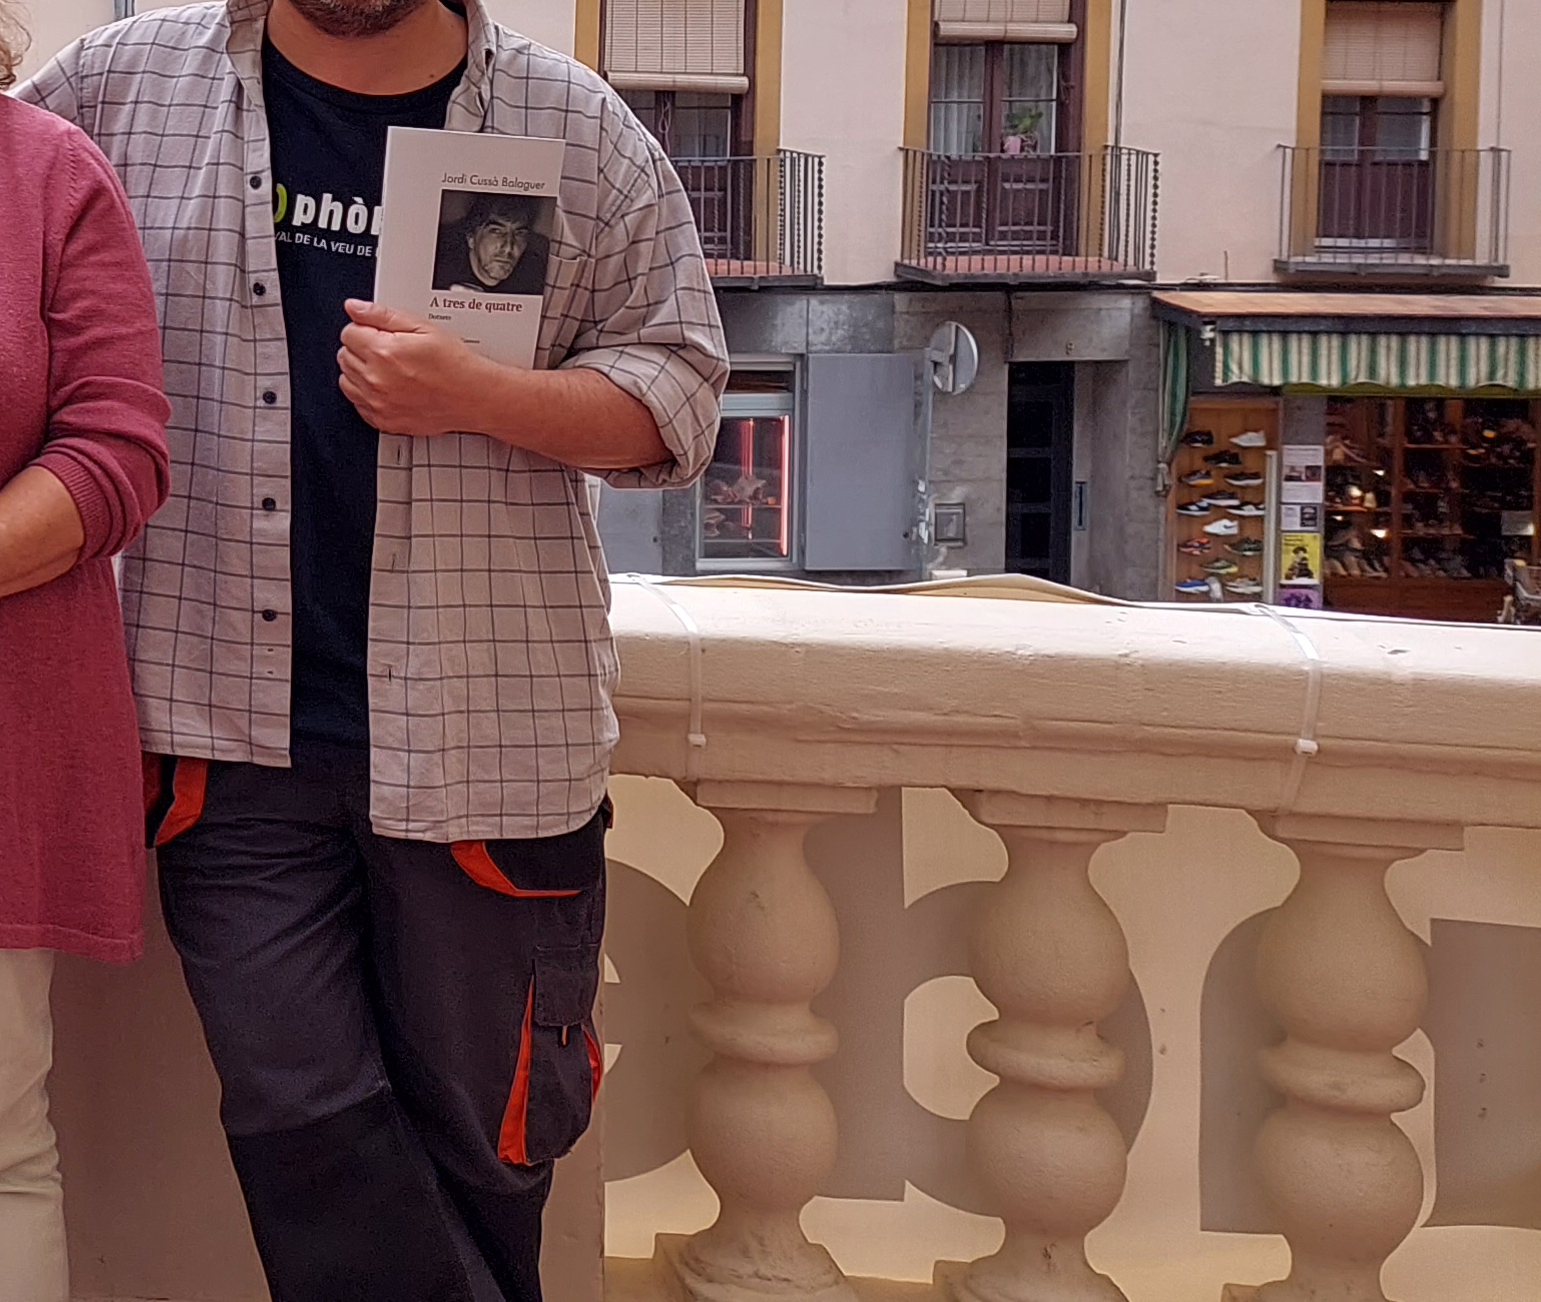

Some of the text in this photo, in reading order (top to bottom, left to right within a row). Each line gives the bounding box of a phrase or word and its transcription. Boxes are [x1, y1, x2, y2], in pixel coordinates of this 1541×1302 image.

[441, 172, 546, 191] Jordi Cussà Balaguer
[294, 232, 311, 245] DE
[313, 236, 328, 251] LA
[330, 241, 355, 254] VEU
[357, 245, 373, 257] DE
[429, 297, 523, 313] A tres de quatre
